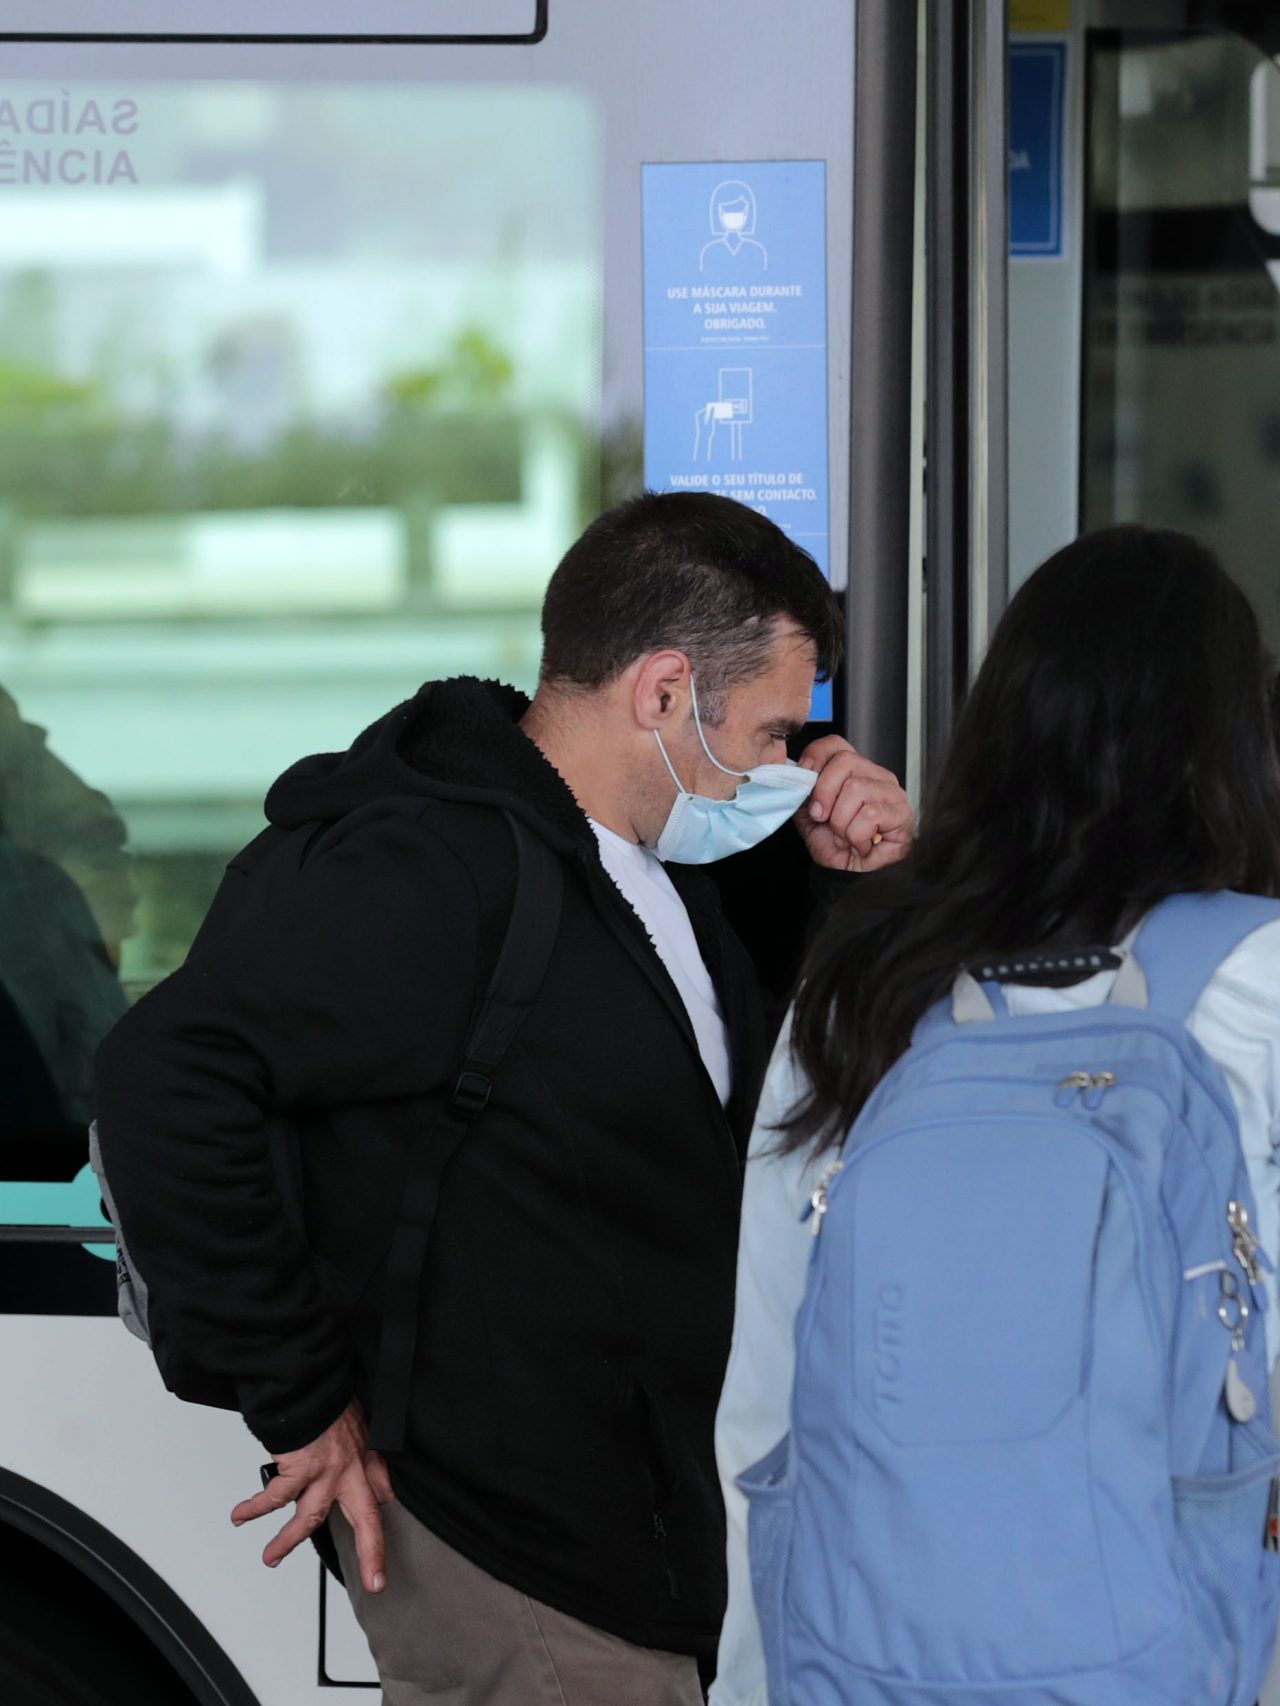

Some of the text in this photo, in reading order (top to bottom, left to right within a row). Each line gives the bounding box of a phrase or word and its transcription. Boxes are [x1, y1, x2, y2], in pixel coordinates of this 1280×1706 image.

[667, 285, 802, 299] USE MÁSCARA DURANTE
[693, 301, 776, 314] A SUA VIAGEM.
[704, 318, 766, 330] OBRIGADO.
[670, 471, 803, 486] VALIDE O SEU TÍTULO DE
[757, 489, 817, 501] CONTACTO.
